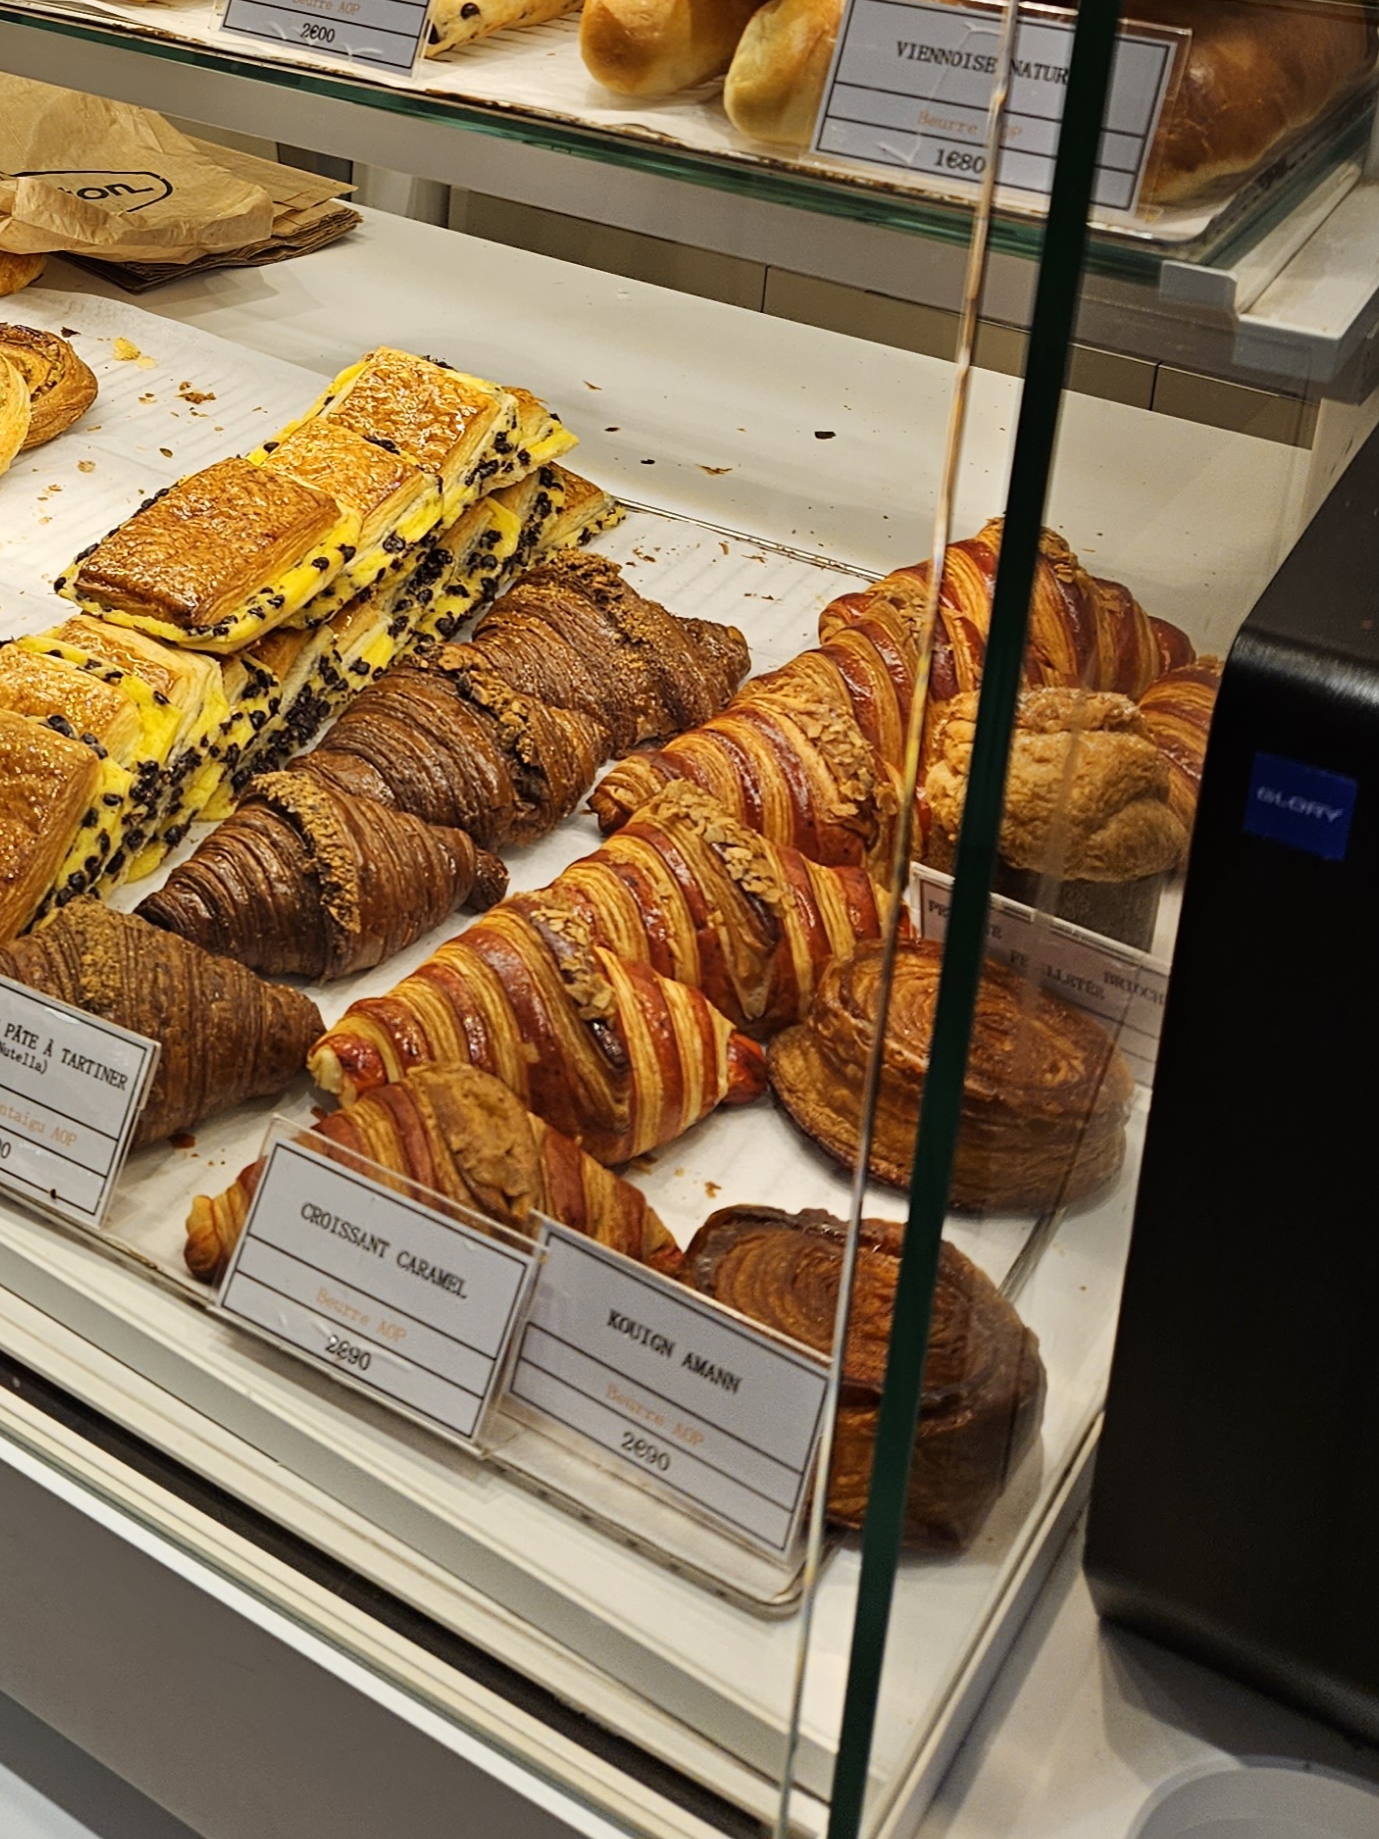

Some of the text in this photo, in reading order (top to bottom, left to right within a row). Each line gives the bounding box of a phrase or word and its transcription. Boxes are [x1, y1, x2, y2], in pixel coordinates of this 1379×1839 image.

[338, 1, 361, 16] AOP
[300, 22, 335, 43] 2€00
[896, 41, 1070, 85] VIENNOISE NATUR
[934, 148, 986, 174] 1€80
[4, 1022, 40, 1050] PÂTE
[42, 1037, 57, 1057] À
[60, 1048, 129, 1091] TARTINER
[50, 1126, 78, 1147] AOP
[300, 1201, 468, 1300] CROISSANT CARAMEL
[324, 1333, 373, 1372] 2€90
[606, 1308, 744, 1396] KOUIGN AMANN
[620, 1430, 673, 1473] 2€90
